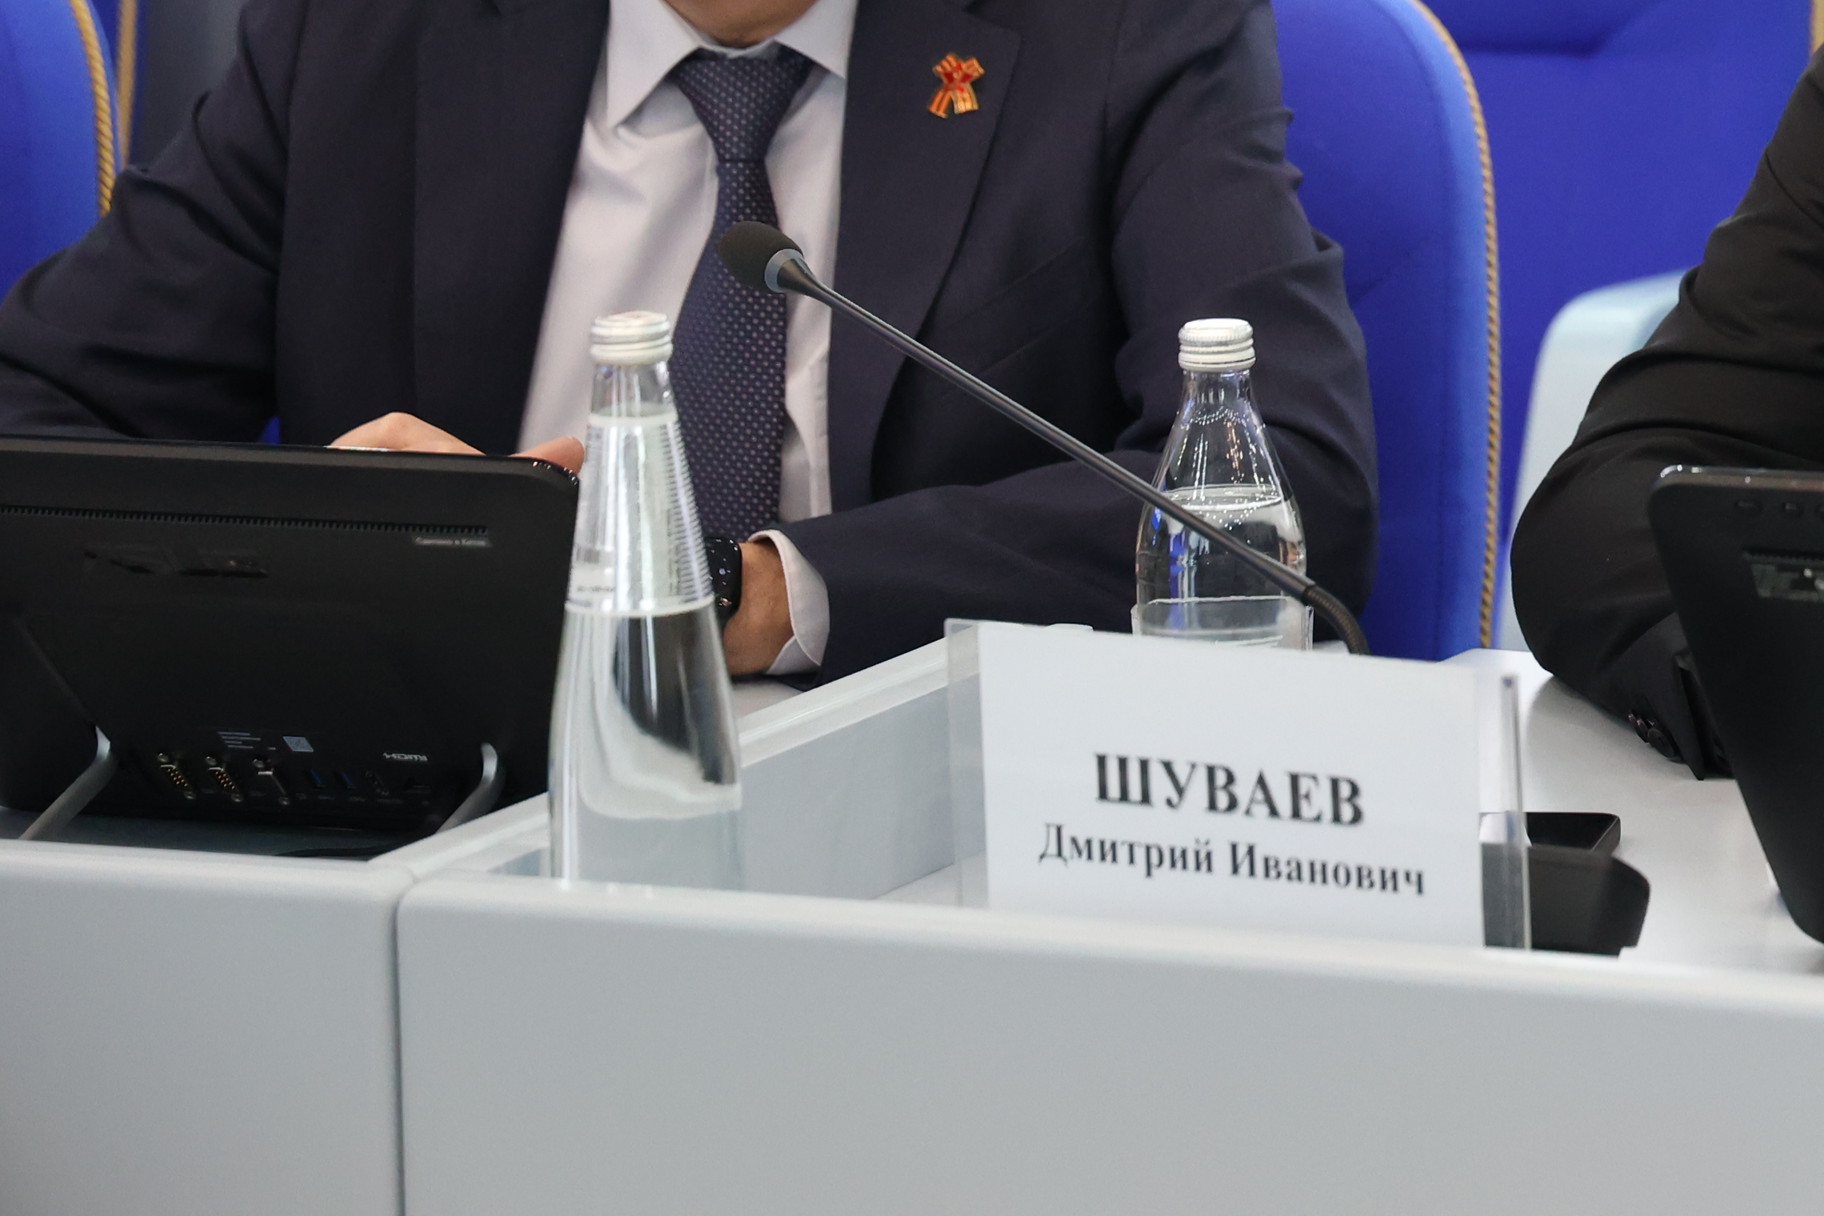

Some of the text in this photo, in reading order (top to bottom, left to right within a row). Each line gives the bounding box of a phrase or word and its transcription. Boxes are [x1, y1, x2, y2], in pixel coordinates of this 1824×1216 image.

[1094, 751, 1365, 827] ШУВАЕВ
[1038, 822, 1426, 896] Дмитрий Иванович
